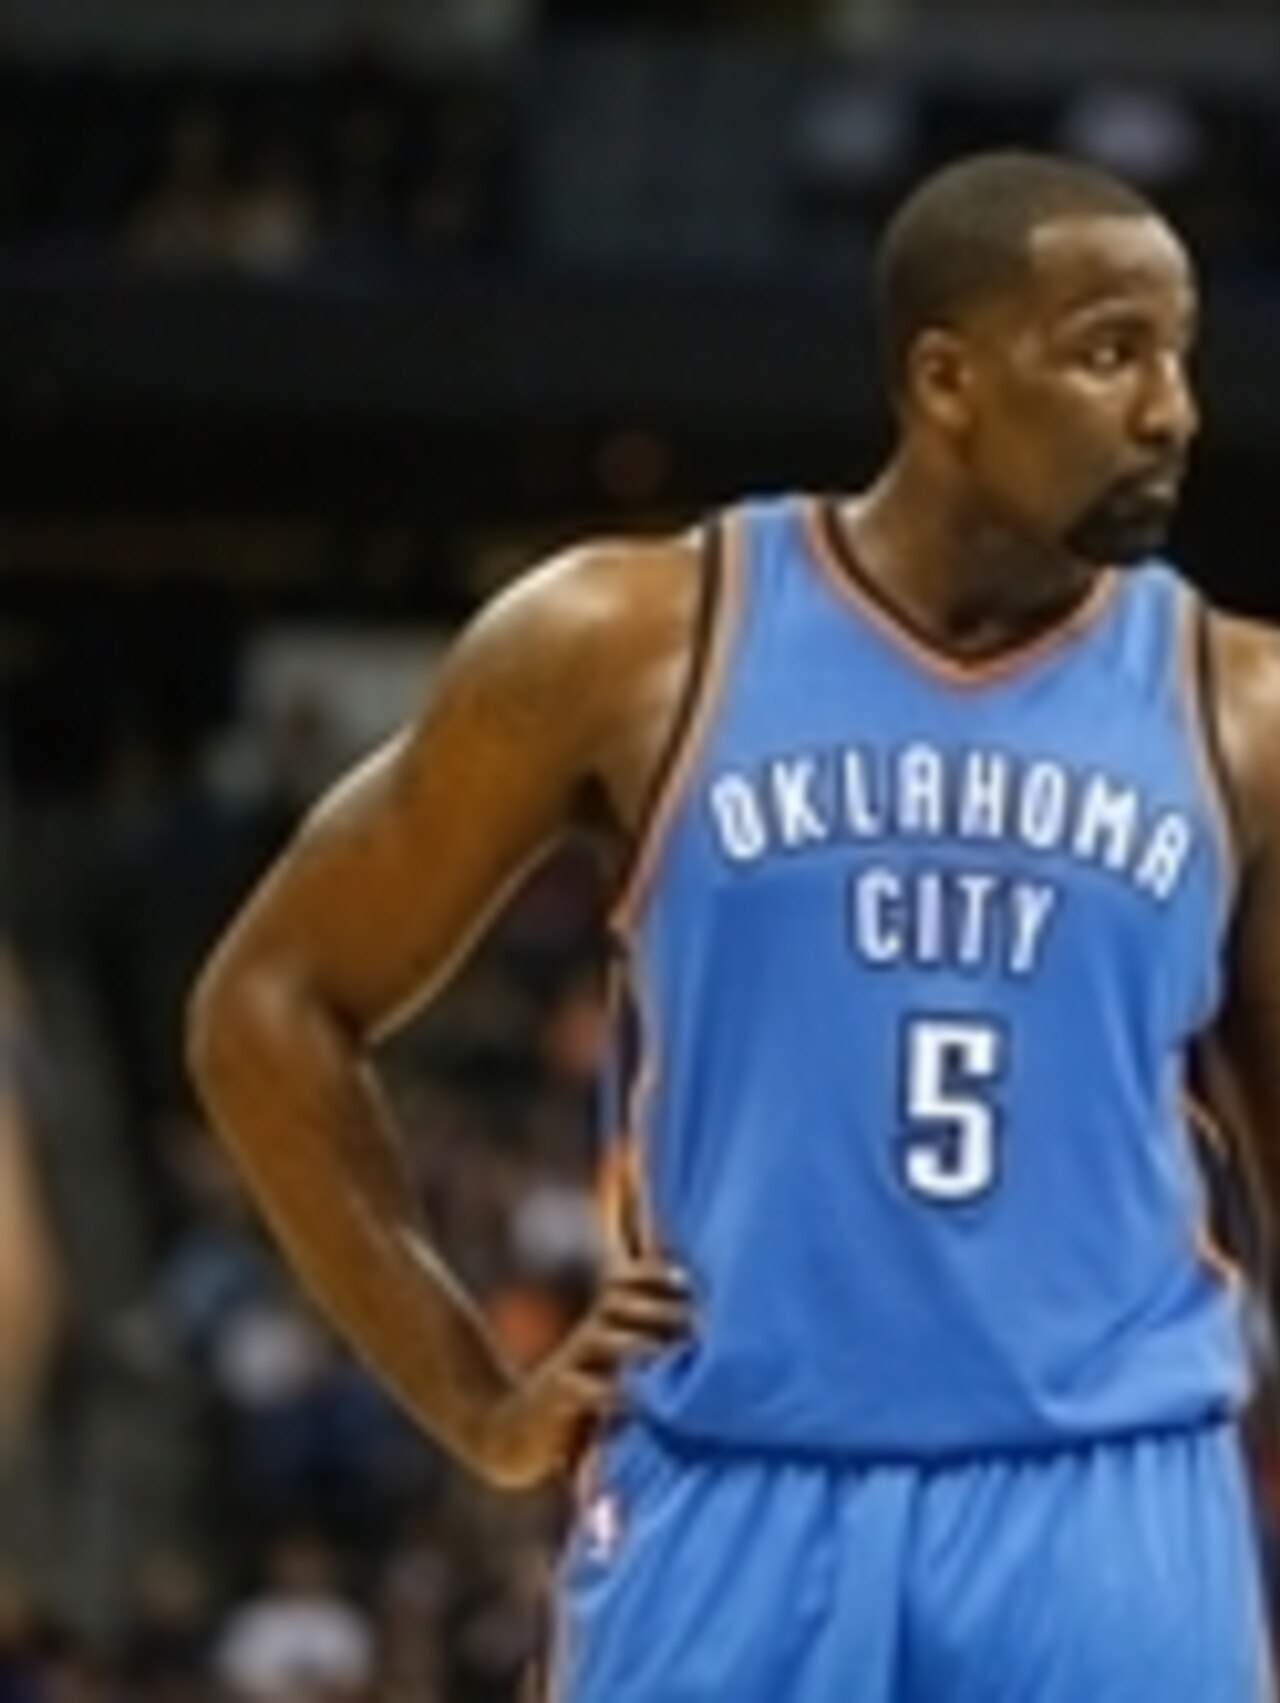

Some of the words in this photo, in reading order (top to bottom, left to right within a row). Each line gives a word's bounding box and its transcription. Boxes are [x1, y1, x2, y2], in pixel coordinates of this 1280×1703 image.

[708, 740, 1192, 900] OKLAHOMA
[852, 865, 1058, 975] CITY
[902, 1016, 1000, 1201] 5
